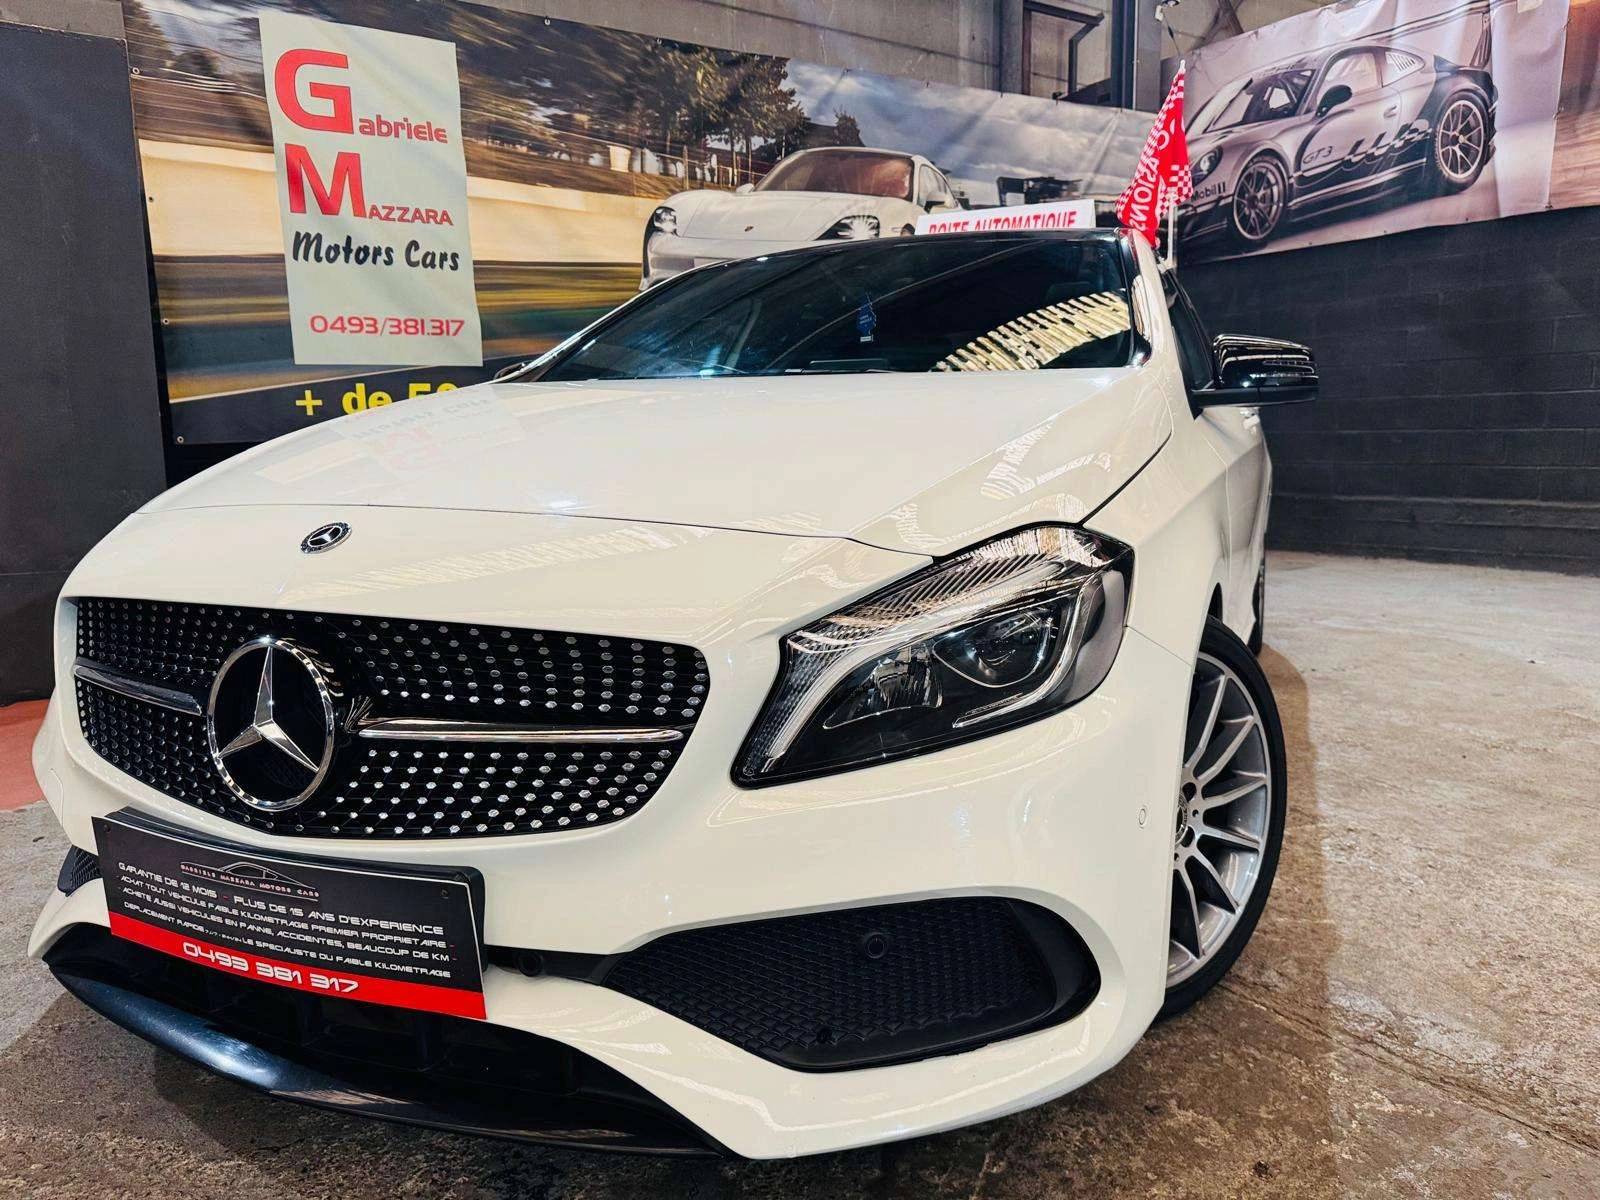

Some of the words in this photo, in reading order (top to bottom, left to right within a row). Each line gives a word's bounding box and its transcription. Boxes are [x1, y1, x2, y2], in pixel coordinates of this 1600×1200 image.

[274, 48, 448, 144] Gabriele
[284, 143, 454, 226] MAZZARA
[292, 231, 394, 266] Motors
[405, 239, 460, 272] Cars
[309, 314, 465, 338] 0493/381.317
[118, 862, 163, 883] GARANTIE
[164, 876, 179, 888] DE
[192, 885, 218, 899] MOIS
[233, 895, 267, 910] PLUS
[268, 903, 287, 914] DE
[289, 907, 304, 917] 15
[307, 910, 336, 922] ANS
[338, 914, 444, 935] D'EXPERIENCE
[120, 875, 145, 888] ACHAT
[145, 883, 166, 895] TOUT
[167, 890, 207, 908] VEHICULE
[240, 910, 309, 930] KILOMETRAGE
[311, 924, 359, 938] PREMIER
[361, 931, 447, 948] PROPRIETAIRE
[123, 887, 152, 903] ACHETE
[153, 897, 176, 910] AUSSI
[177, 904, 223, 924] VEHICULES
[225, 918, 238, 928] EN
[346, 941, 410, 956] BEAUCOUP
[412, 950, 429, 960] DE
[431, 953, 450, 962] KM
[182, 941, 249, 972] 0493
[255, 961, 303, 985] 381
[309, 973, 359, 993] 317
[255, 940, 318, 959] SPECIALISTE
[318, 952, 334, 962] DU
[336, 956, 373, 967] FAIBLE
[374, 962, 451, 978] KILOMETRAGE
